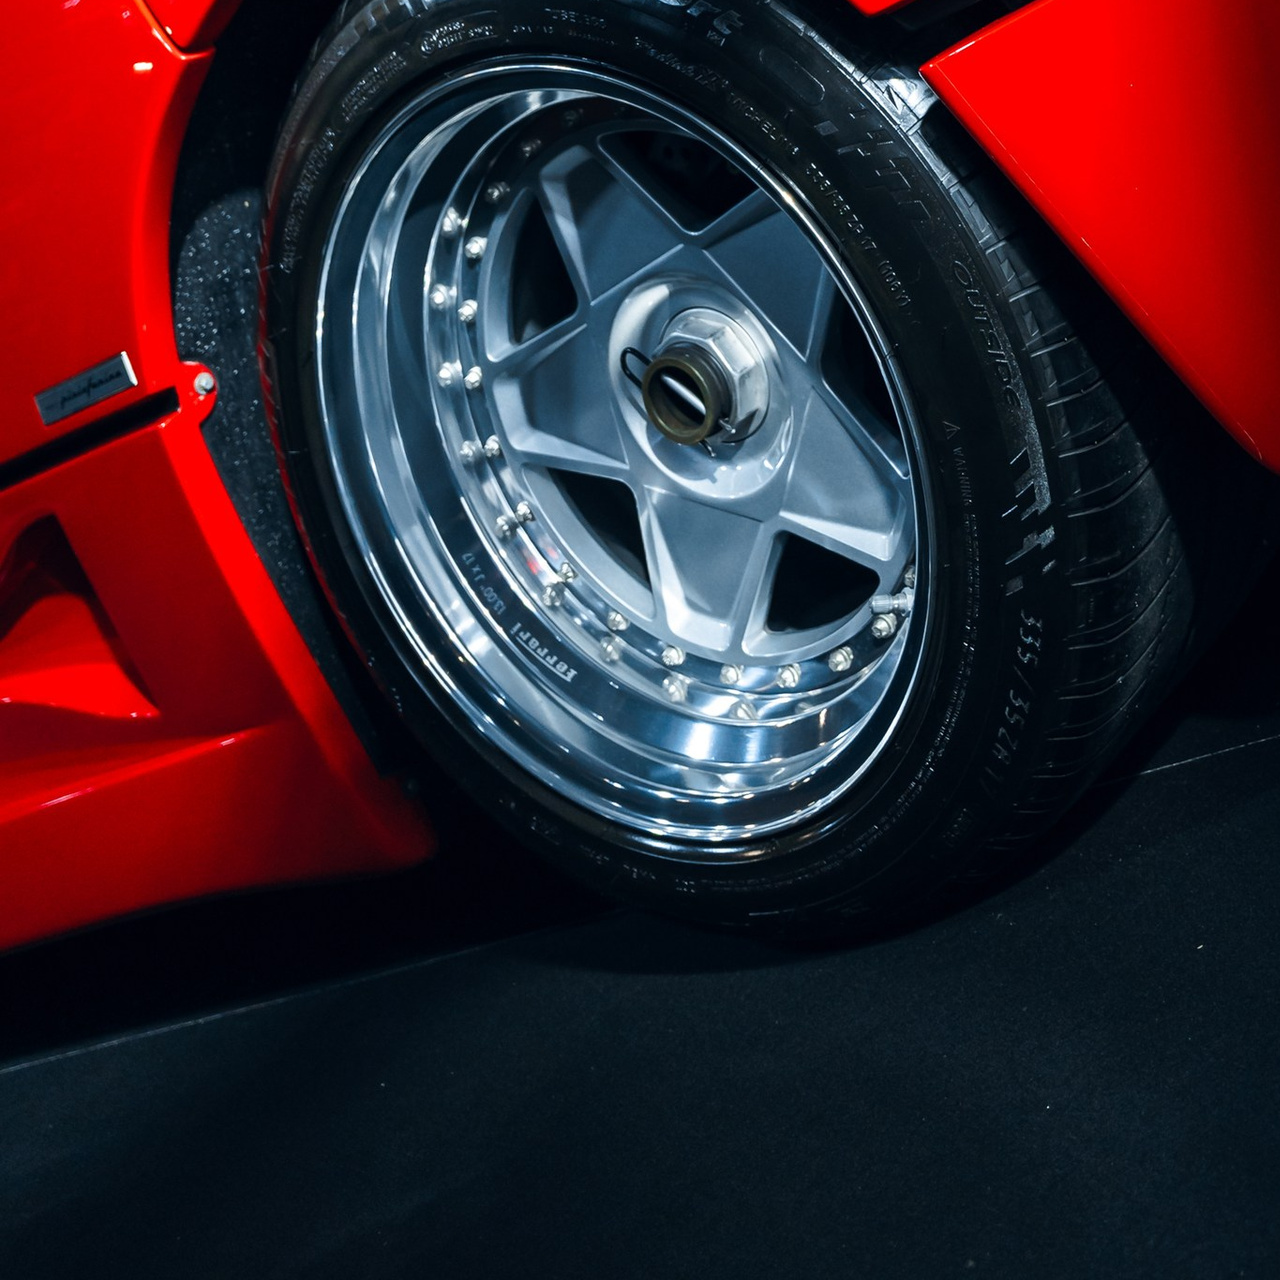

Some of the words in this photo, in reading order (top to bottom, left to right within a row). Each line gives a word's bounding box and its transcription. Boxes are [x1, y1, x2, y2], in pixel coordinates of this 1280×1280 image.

[952, 258, 1023, 411] OUTSIDE
[510, 621, 578, 682] Ferrari
[1004, 608, 1042, 727] 335/35
